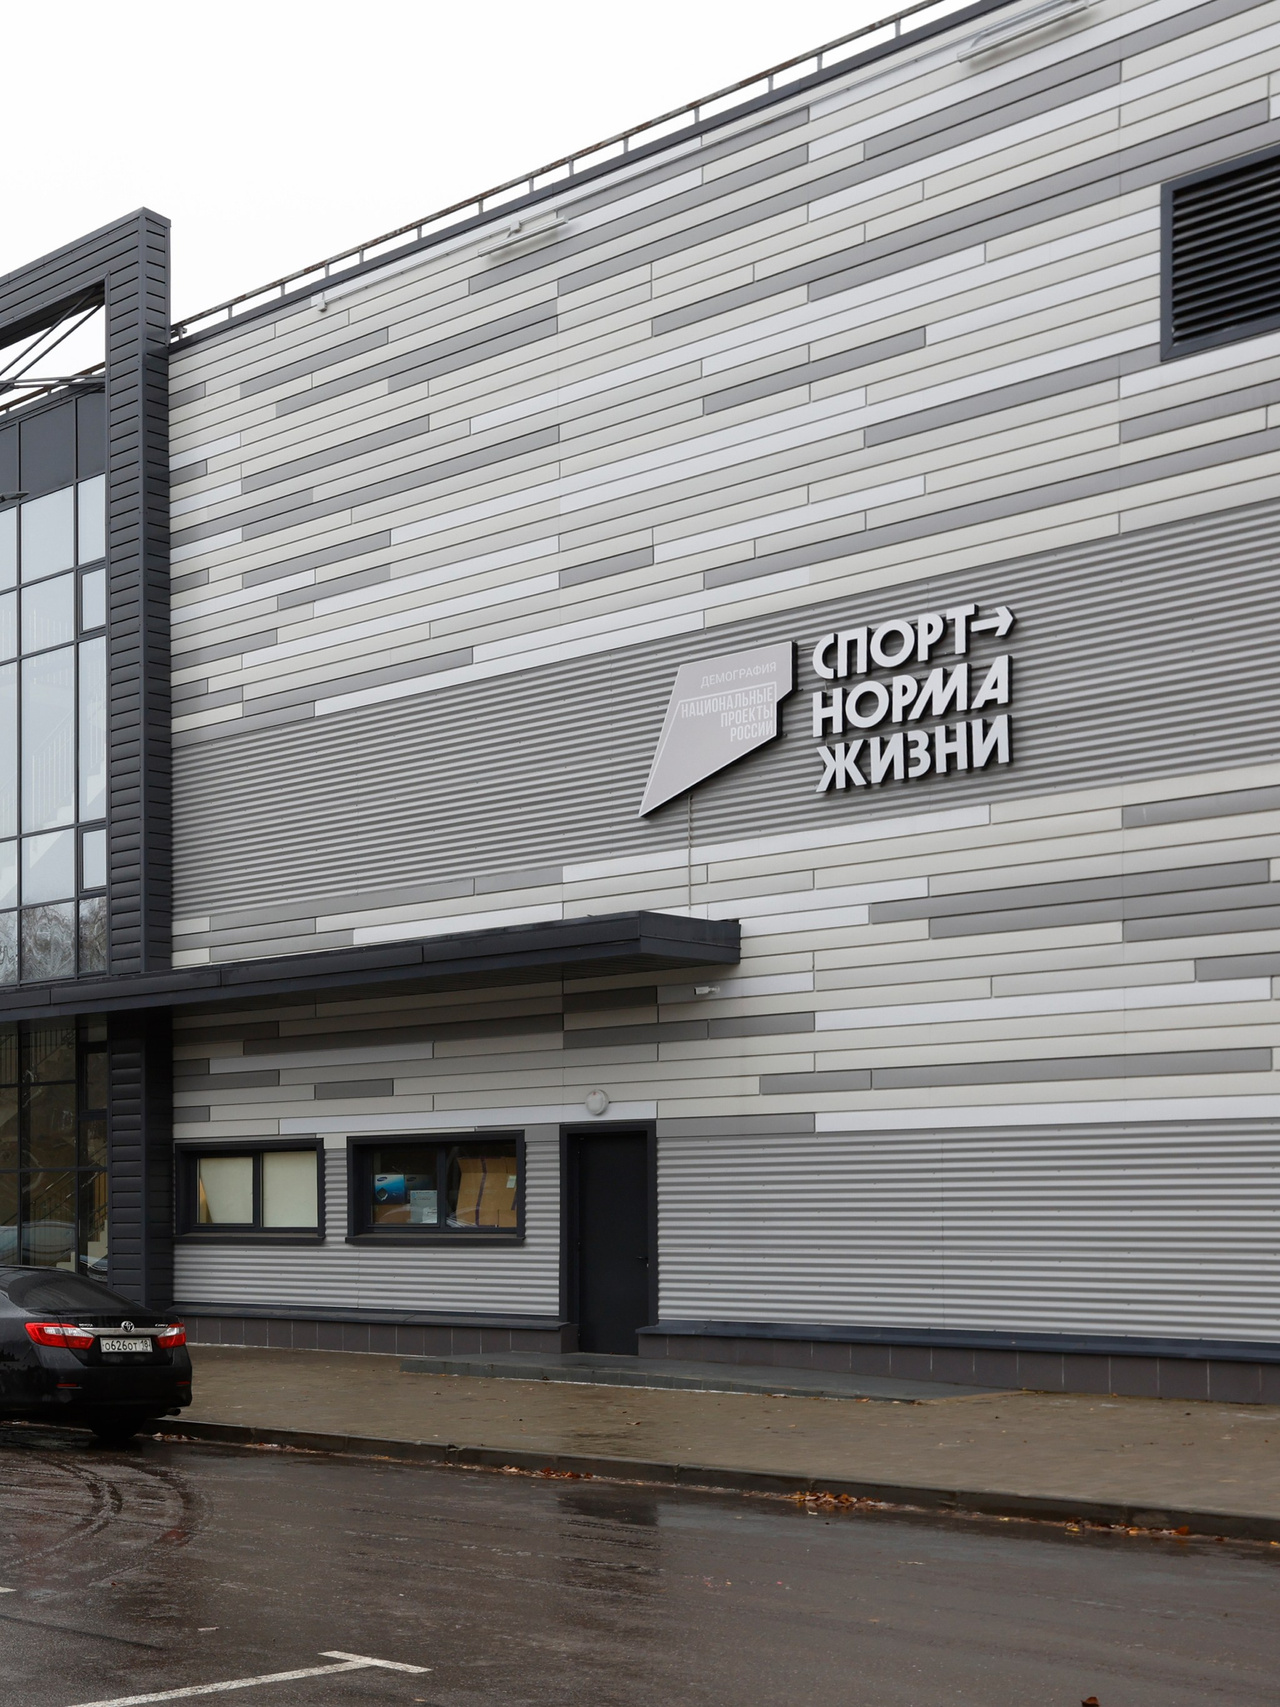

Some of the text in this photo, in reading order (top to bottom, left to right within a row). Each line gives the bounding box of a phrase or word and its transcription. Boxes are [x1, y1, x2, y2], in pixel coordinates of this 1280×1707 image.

[812, 604, 977, 679] СПОРТ
[700, 661, 777, 689] ДЕМОГРАФИЯ
[681, 686, 774, 718] НАЦИОНАЛЬНЫЕ
[812, 654, 1010, 738] НОРМА
[720, 702, 774, 728] ПРОЕКТЫ
[730, 720, 774, 742] РОССИИ
[816, 714, 1010, 792] ЖИЗНИ
